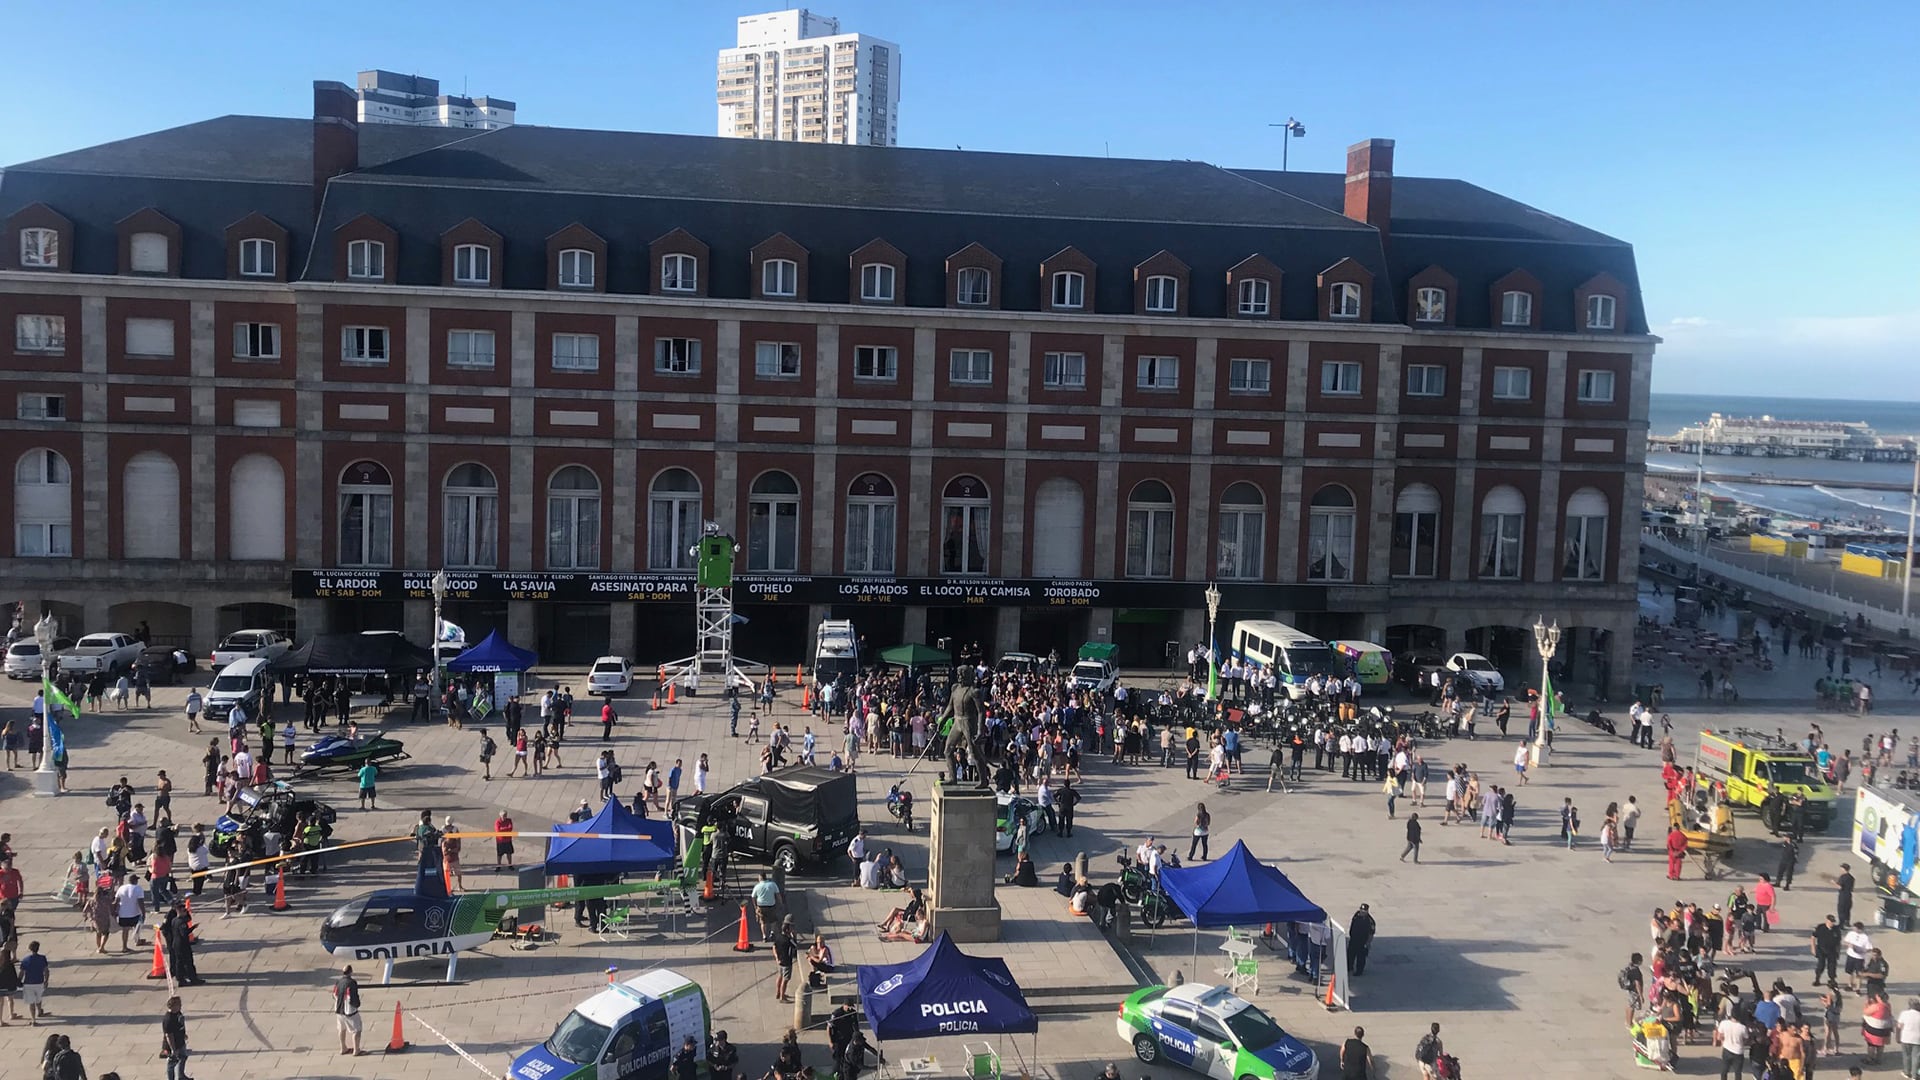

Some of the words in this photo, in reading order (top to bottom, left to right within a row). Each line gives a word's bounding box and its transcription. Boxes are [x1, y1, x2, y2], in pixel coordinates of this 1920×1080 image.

[320, 579, 333, 588] EL
[336, 579, 377, 588] ARDOR
[404, 579, 478, 590] BOLLWOOD
[503, 580, 518, 590] LA
[520, 581, 556, 591] SAVIA
[590, 582, 654, 592] ASESINATO
[656, 582, 688, 592] PARA
[749, 583, 793, 593] OTHELO
[839, 584, 860, 594] LOS
[861, 585, 908, 595] AMADOS
[920, 586, 933, 595] EL
[935, 586, 963, 596] LOCO
[965, 586, 973, 596] Y
[974, 586, 988, 596] LA
[990, 586, 1031, 597] CAMISA
[1044, 587, 1100, 597] JOROBADO
[857, 594, 872, 602] JUE
[355, 939, 456, 961] POLICIA
[920, 999, 988, 1017] POLICIA
[939, 1020, 979, 1032] POLICIA
[1159, 1033, 1191, 1054] POLICIA
[620, 1055, 648, 1077] POLICIA
